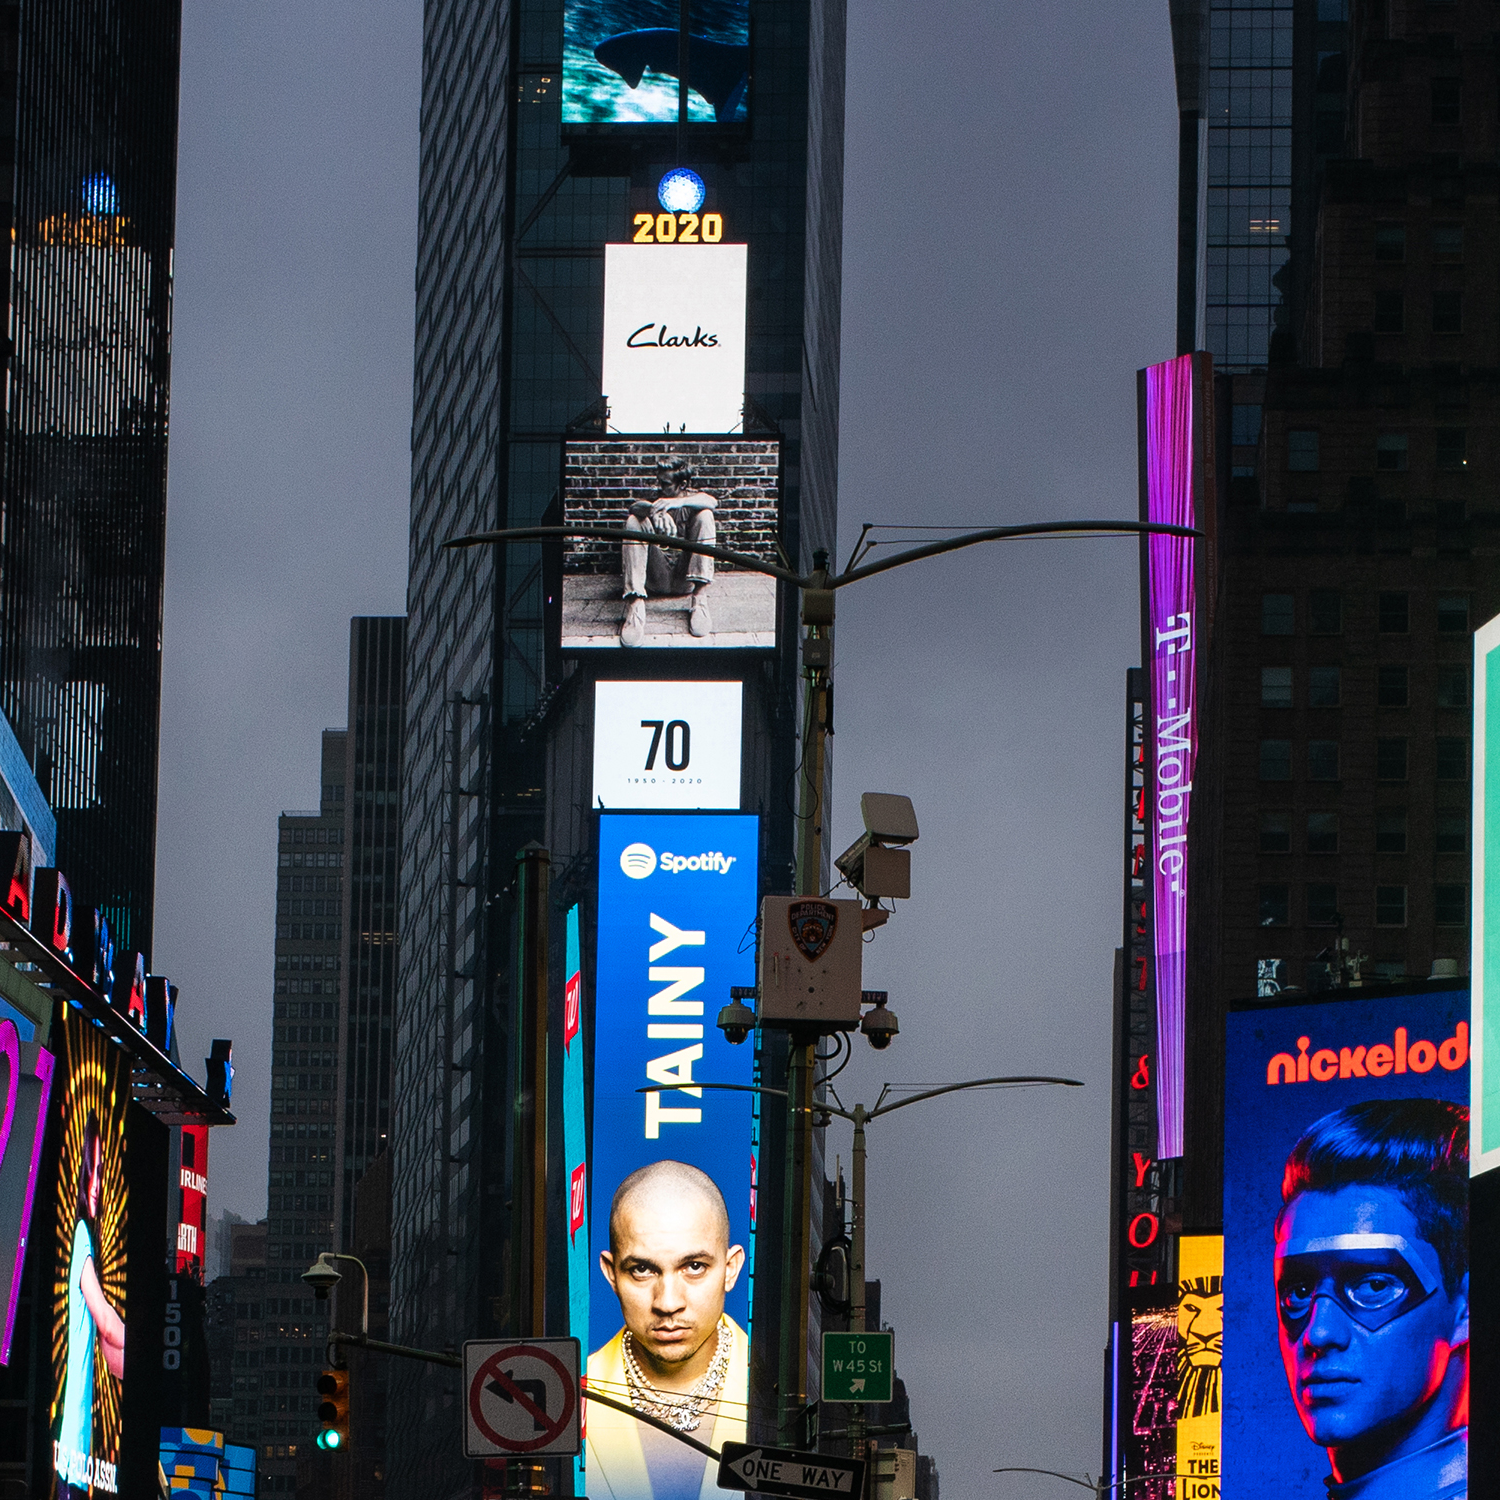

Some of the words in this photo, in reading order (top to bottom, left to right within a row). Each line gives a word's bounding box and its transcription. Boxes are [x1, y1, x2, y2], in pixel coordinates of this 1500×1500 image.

[633, 213, 723, 243] 2020
[626, 322, 720, 349] Clarks
[640, 719, 691, 771] 70
[659, 849, 733, 875] Spotify
[644, 913, 707, 1140] TAINY
[162, 1280, 182, 1371] 1500
[849, 1341, 867, 1354] TO
[832, 1360, 845, 1373] W
[846, 1360, 866, 1373] 45
[868, 1360, 883, 1373] St
[742, 1458, 783, 1481] ONE
[802, 1466, 845, 1489] WAY
[1187, 1459, 1219, 1474] THE
